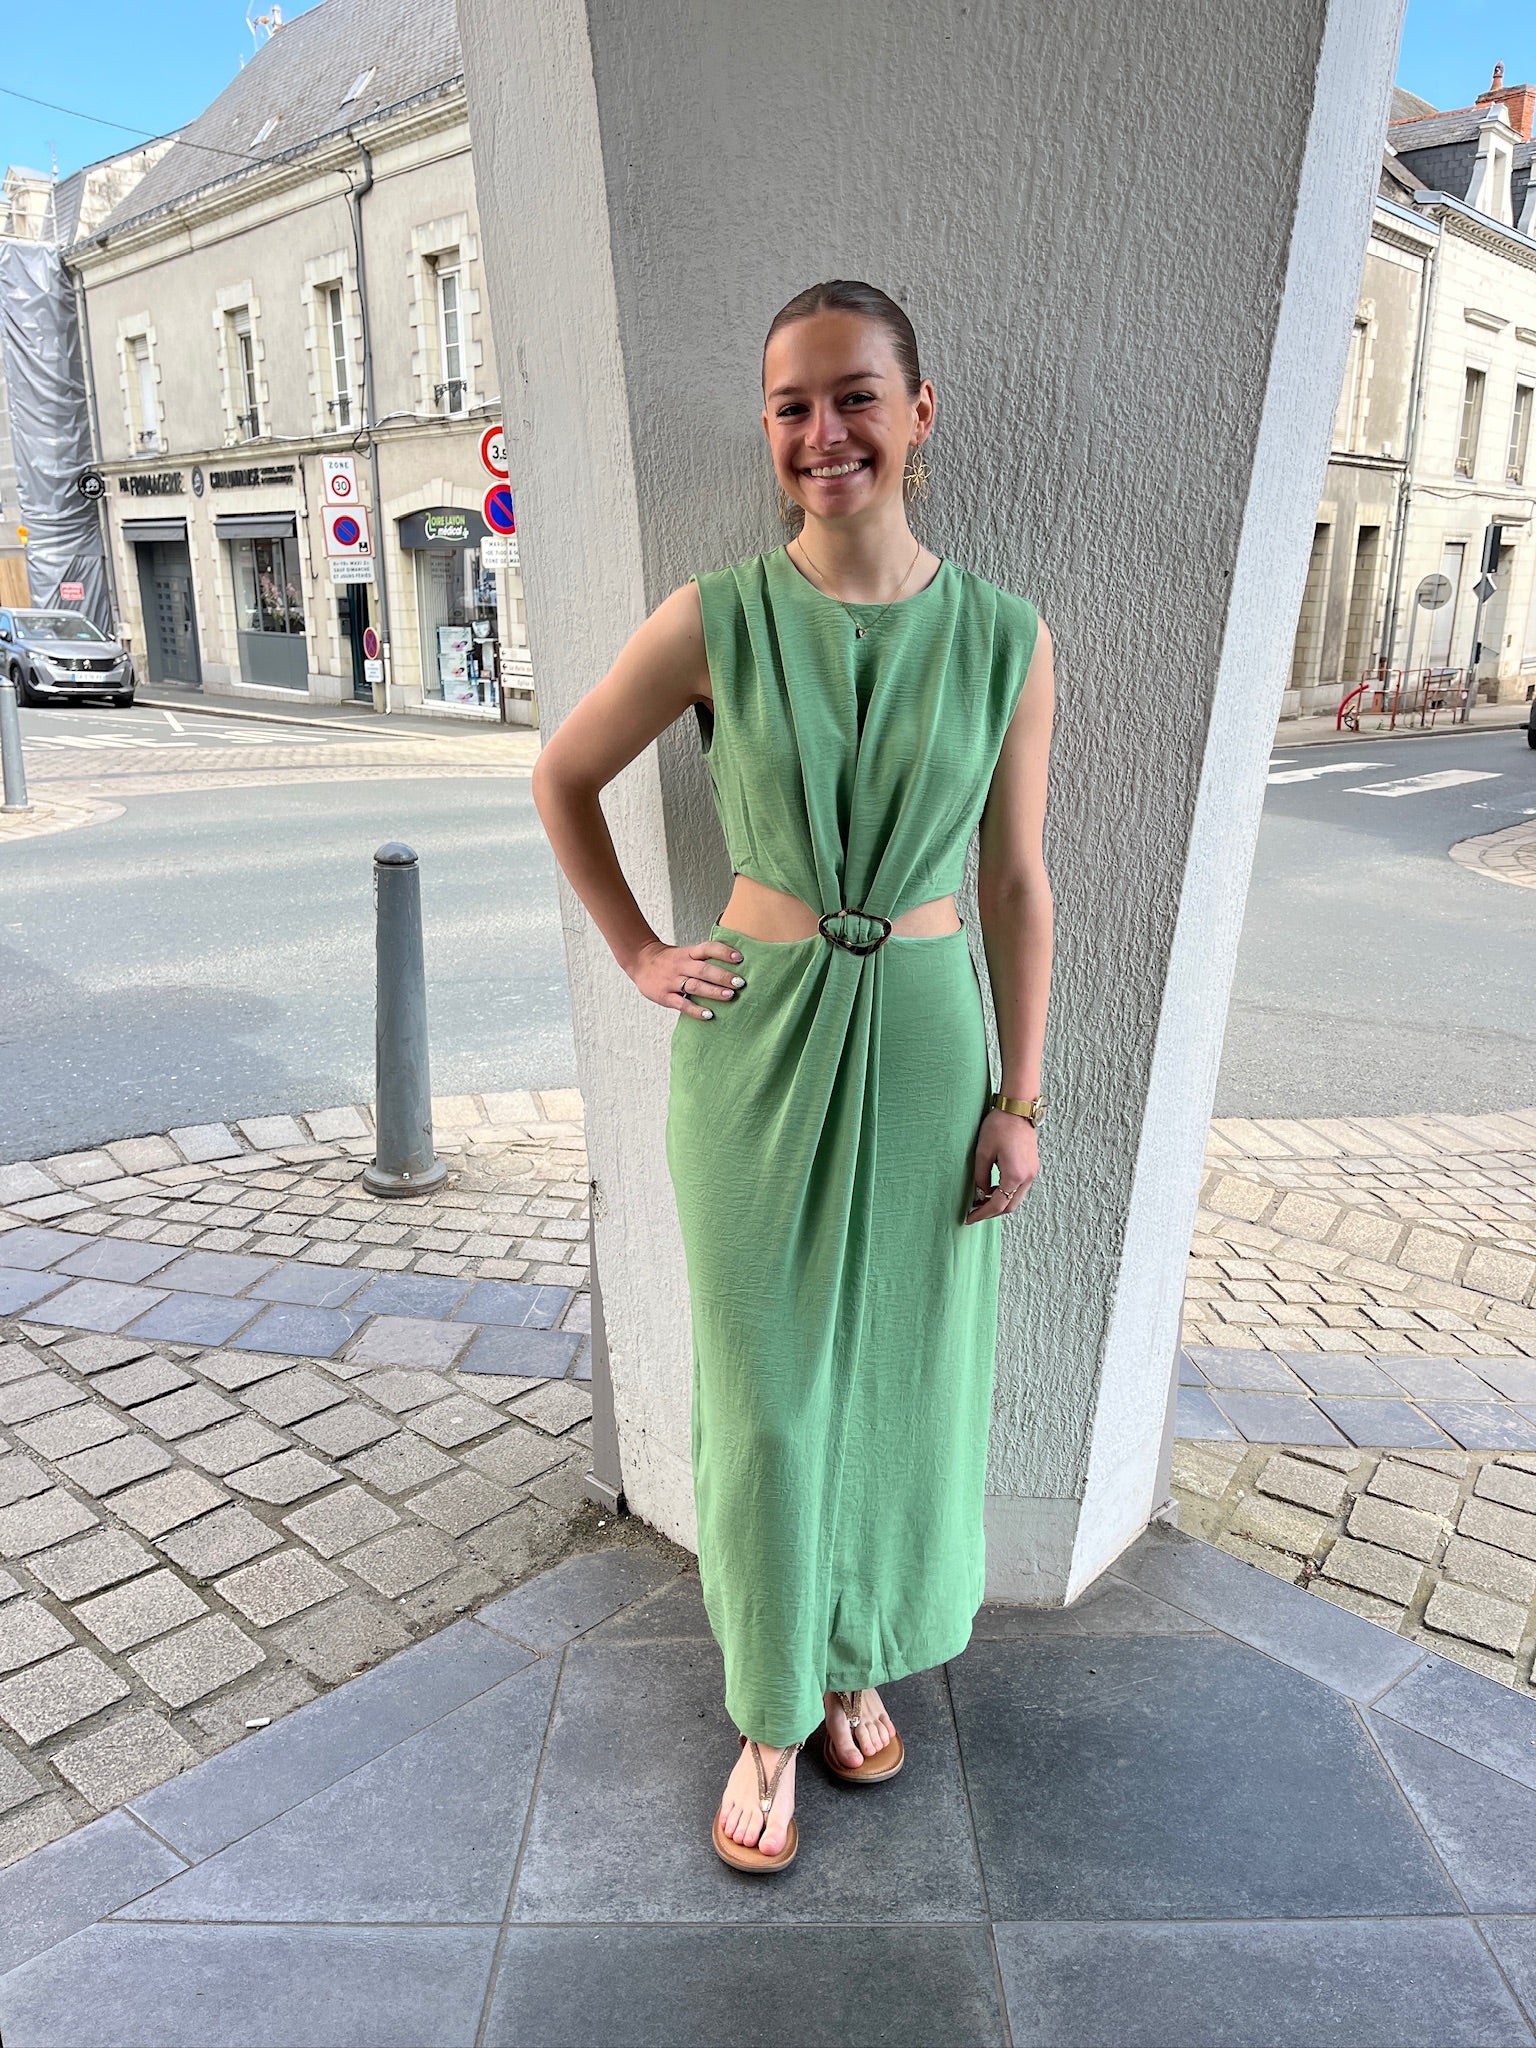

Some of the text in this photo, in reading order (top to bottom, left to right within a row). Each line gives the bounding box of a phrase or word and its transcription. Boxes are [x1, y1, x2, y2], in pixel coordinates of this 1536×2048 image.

[335, 481, 347, 491] 30
[425, 512, 465, 532] LOIRE LAYON
